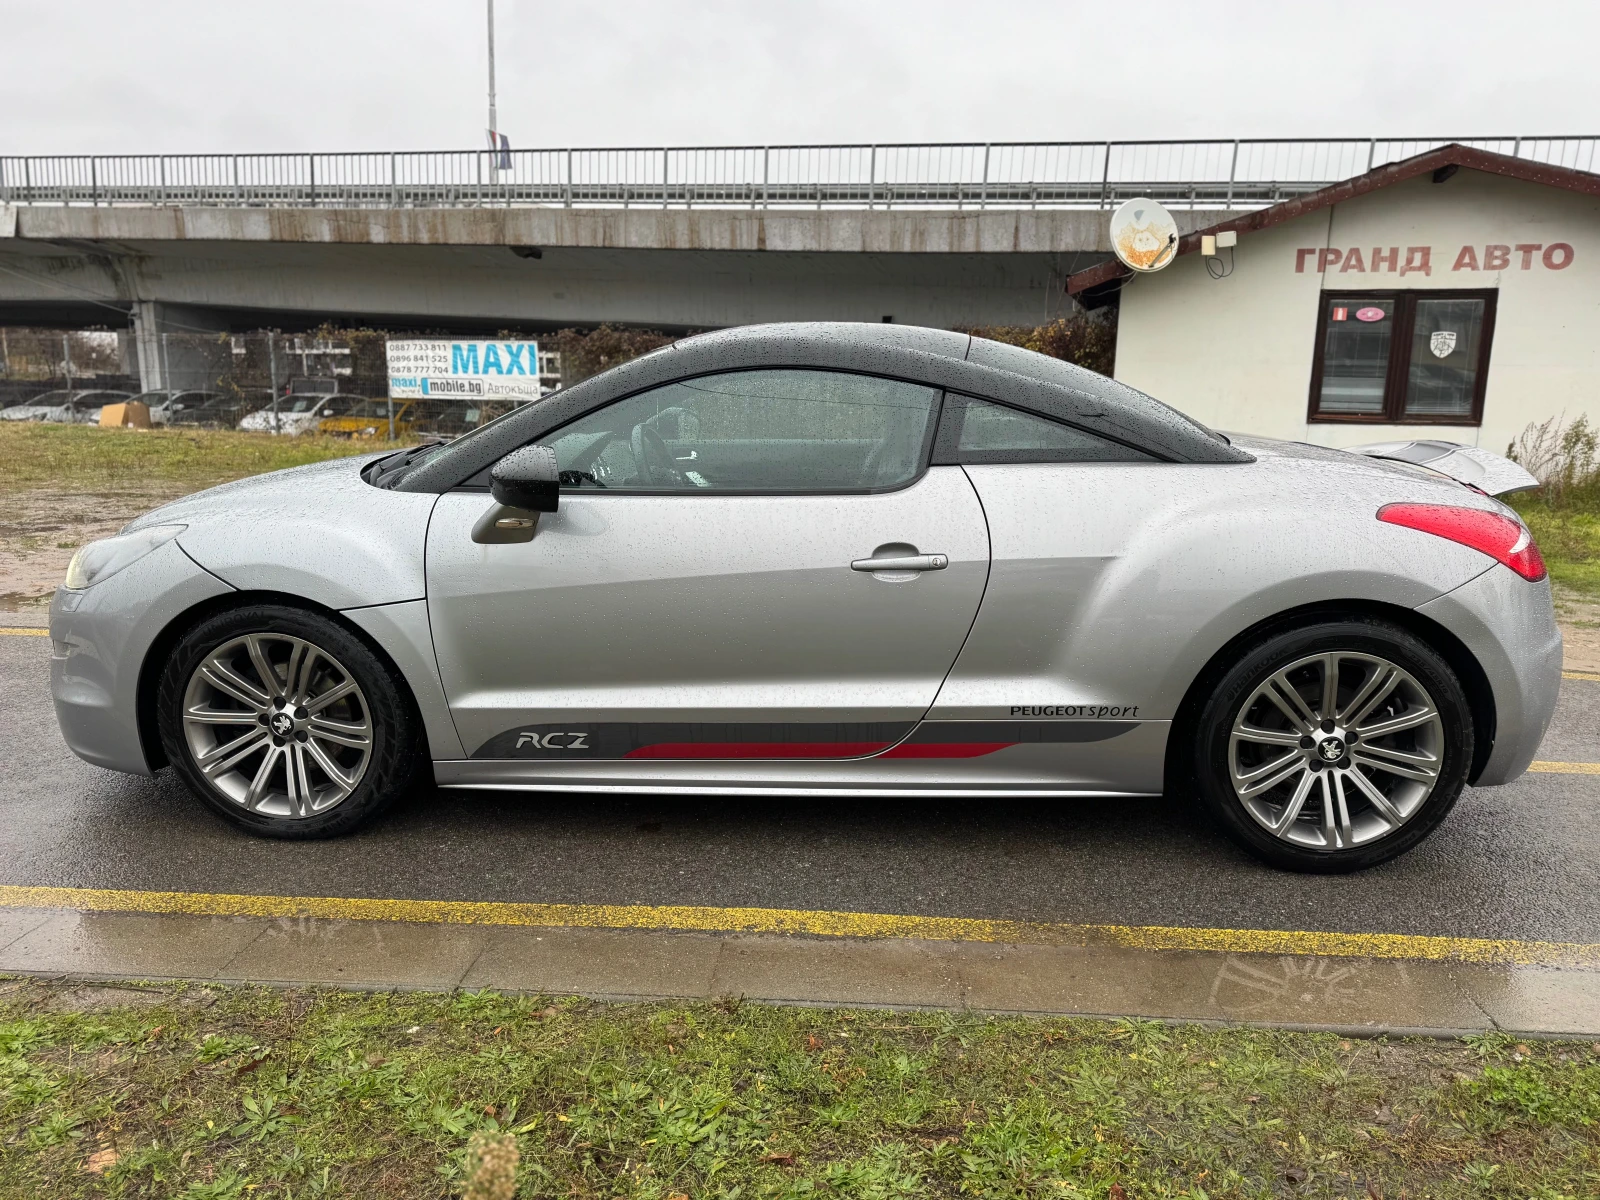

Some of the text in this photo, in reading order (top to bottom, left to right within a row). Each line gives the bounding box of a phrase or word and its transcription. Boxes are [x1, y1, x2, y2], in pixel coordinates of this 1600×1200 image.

[1294, 242, 1575, 277] ГРАНД АВТО
[431, 355, 448, 363] 525
[451, 343, 537, 375] MAXI
[432, 366, 449, 374] 704
[429, 380, 482, 394] mobile.bg
[487, 382, 538, 396] Автокъща
[515, 732, 590, 749] RCZ
